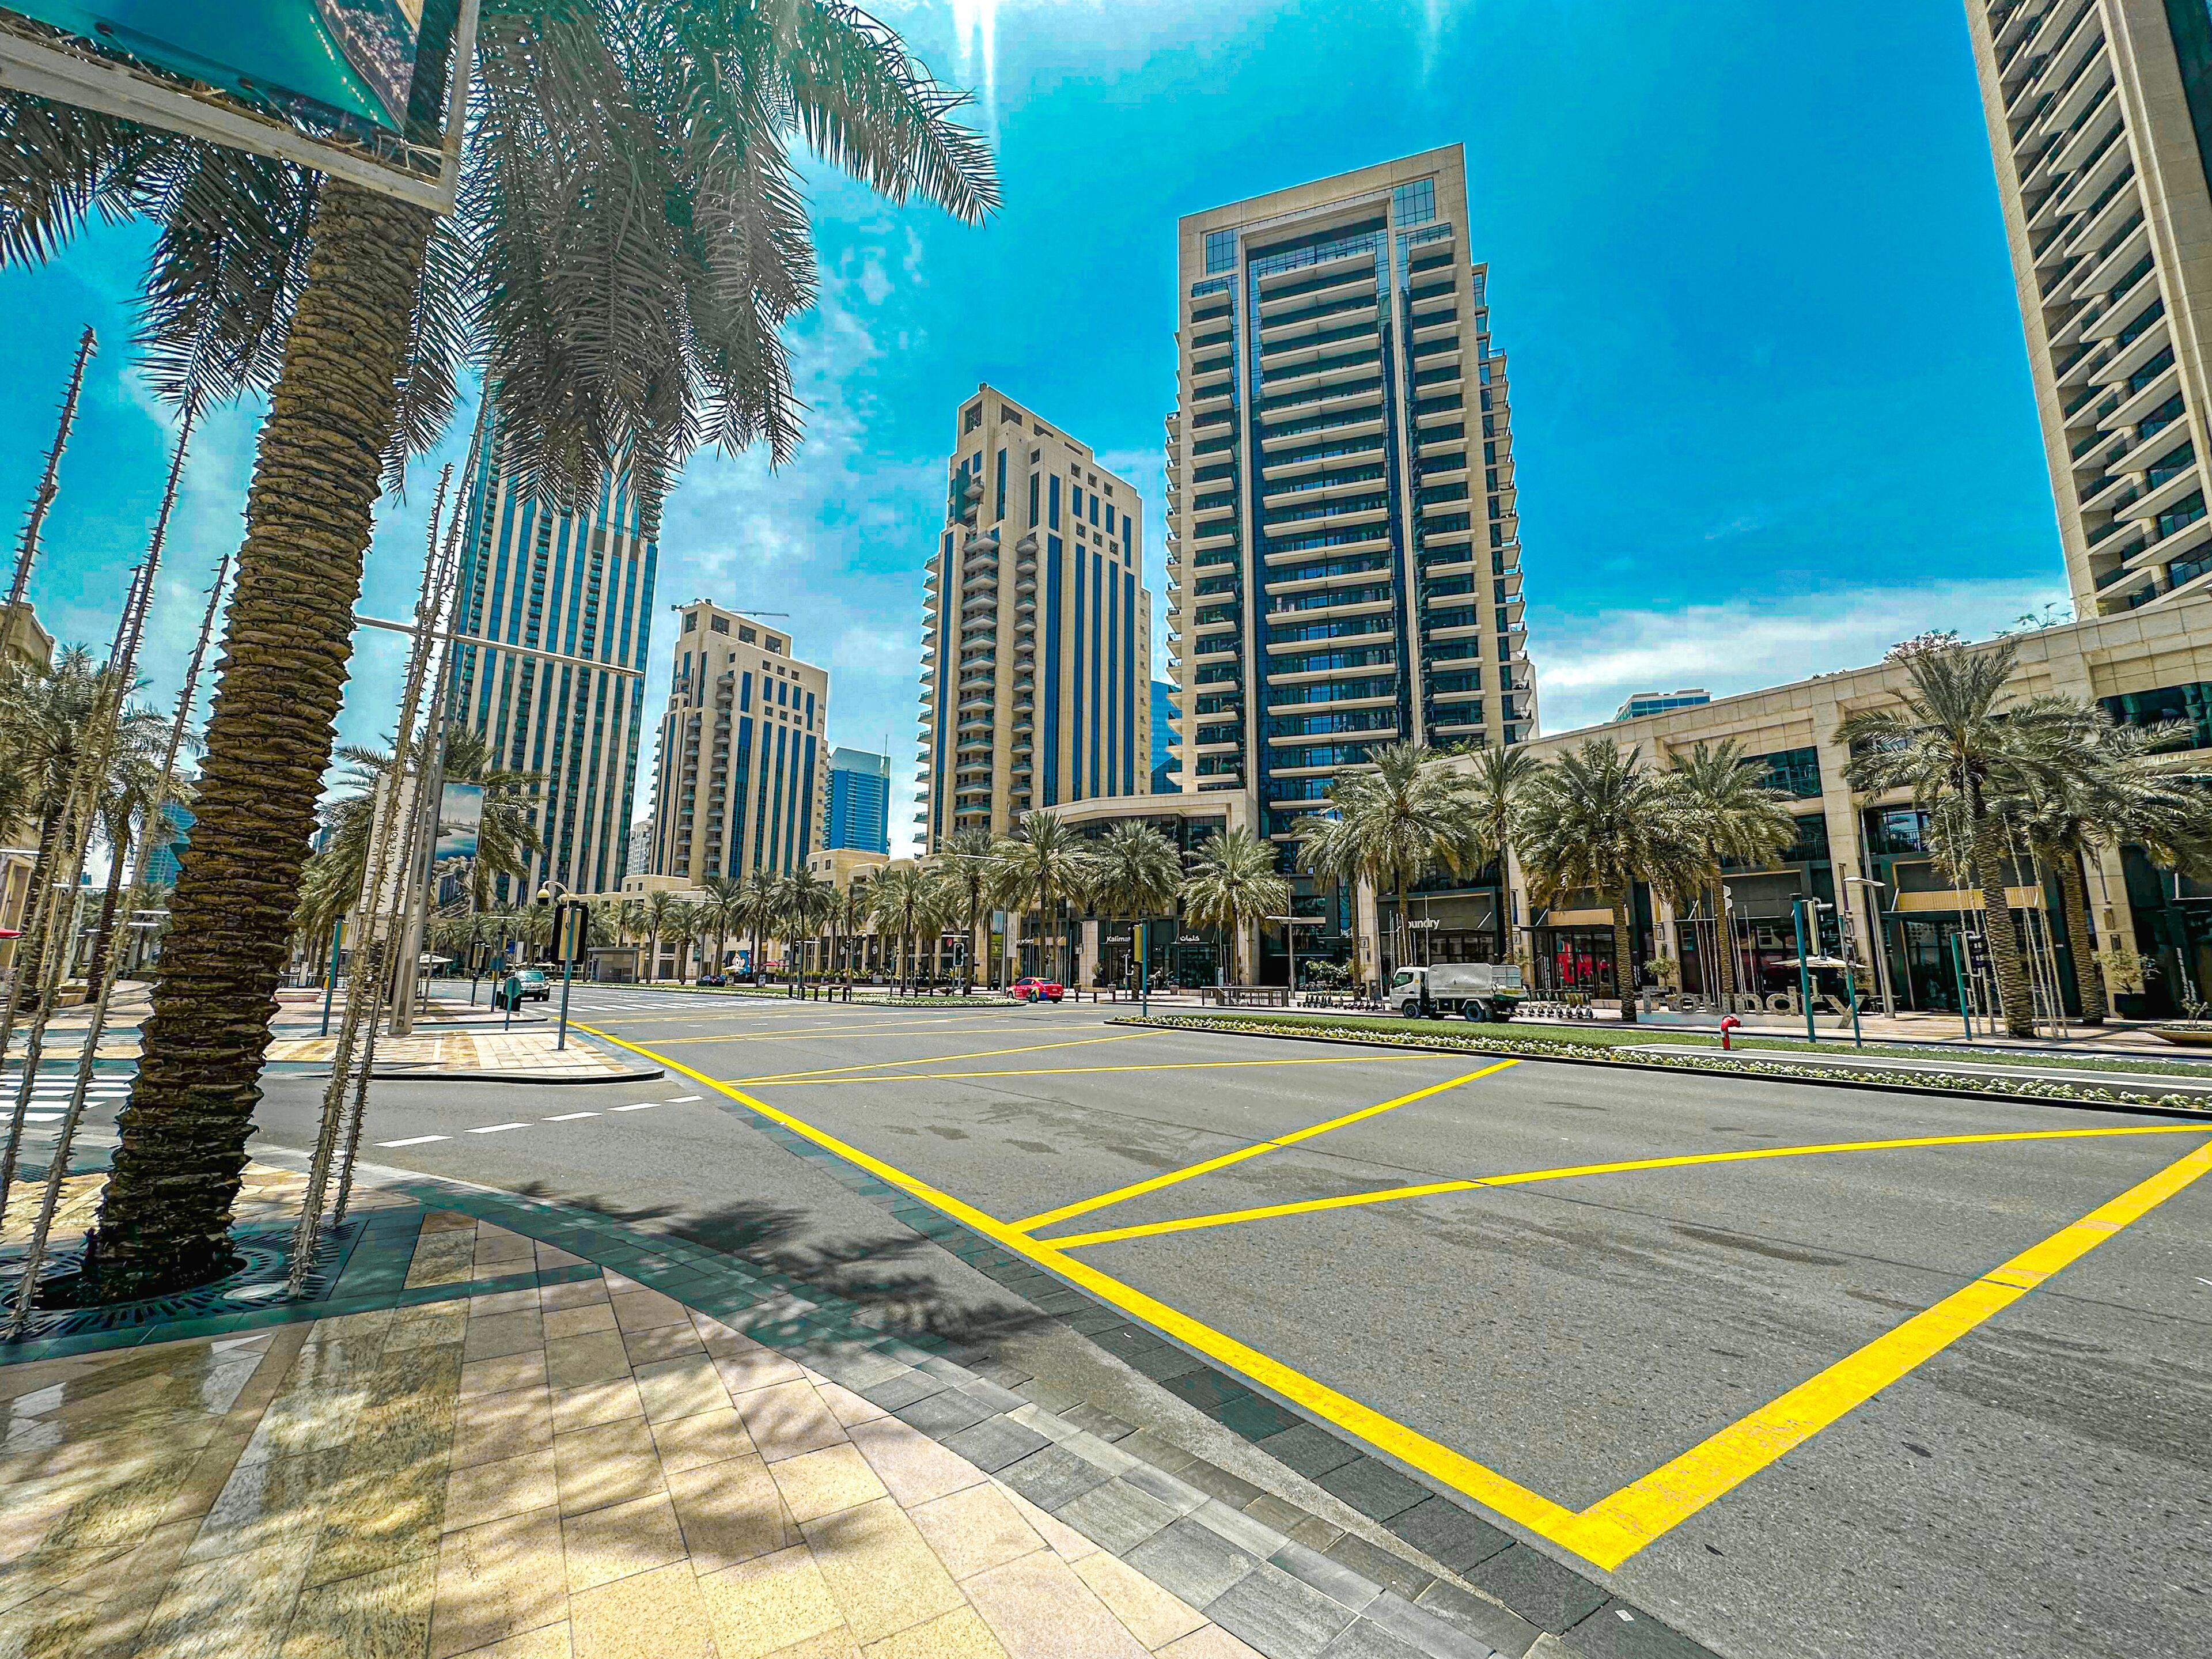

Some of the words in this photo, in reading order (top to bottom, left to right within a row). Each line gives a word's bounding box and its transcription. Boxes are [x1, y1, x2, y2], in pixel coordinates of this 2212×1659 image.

[387, 844, 396, 862] LIVE
[1407, 918, 1440, 930] oundry
[1106, 935, 1131, 943] Kalima
